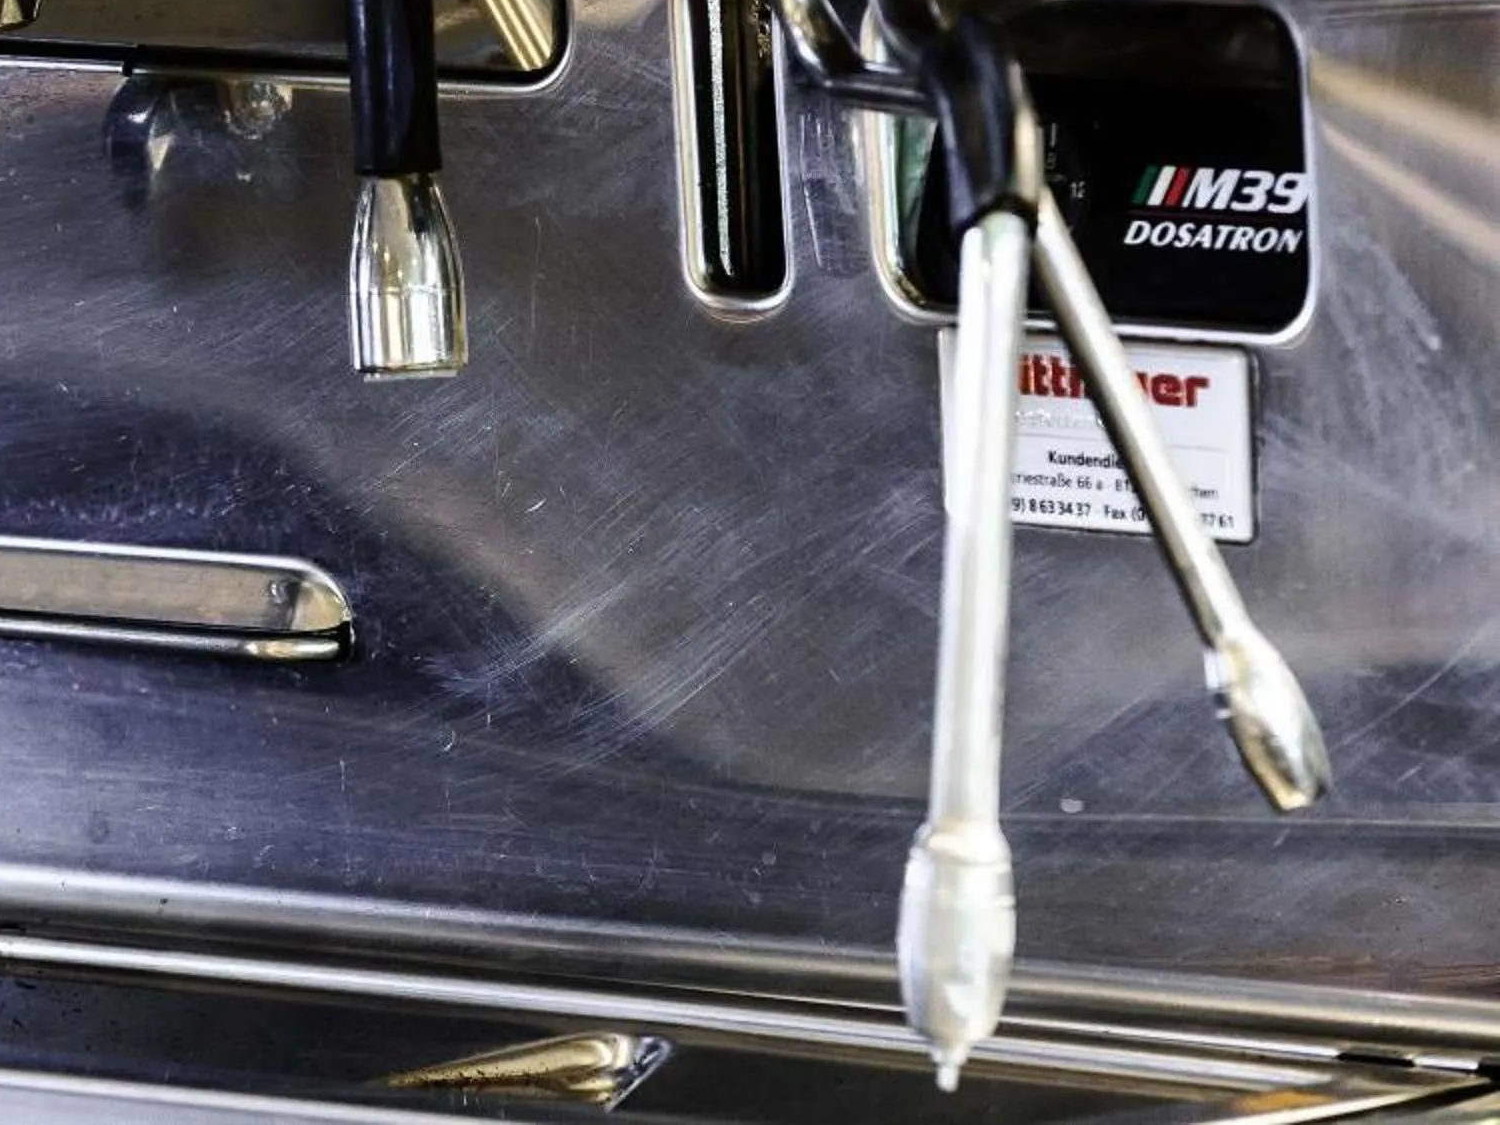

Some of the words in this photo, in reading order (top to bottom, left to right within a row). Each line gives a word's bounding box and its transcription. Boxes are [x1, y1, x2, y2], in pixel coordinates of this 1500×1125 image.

[1181, 166, 1308, 215] M39
[1123, 219, 1302, 254] DOSATRON
[1103, 503, 1127, 520] Fax
